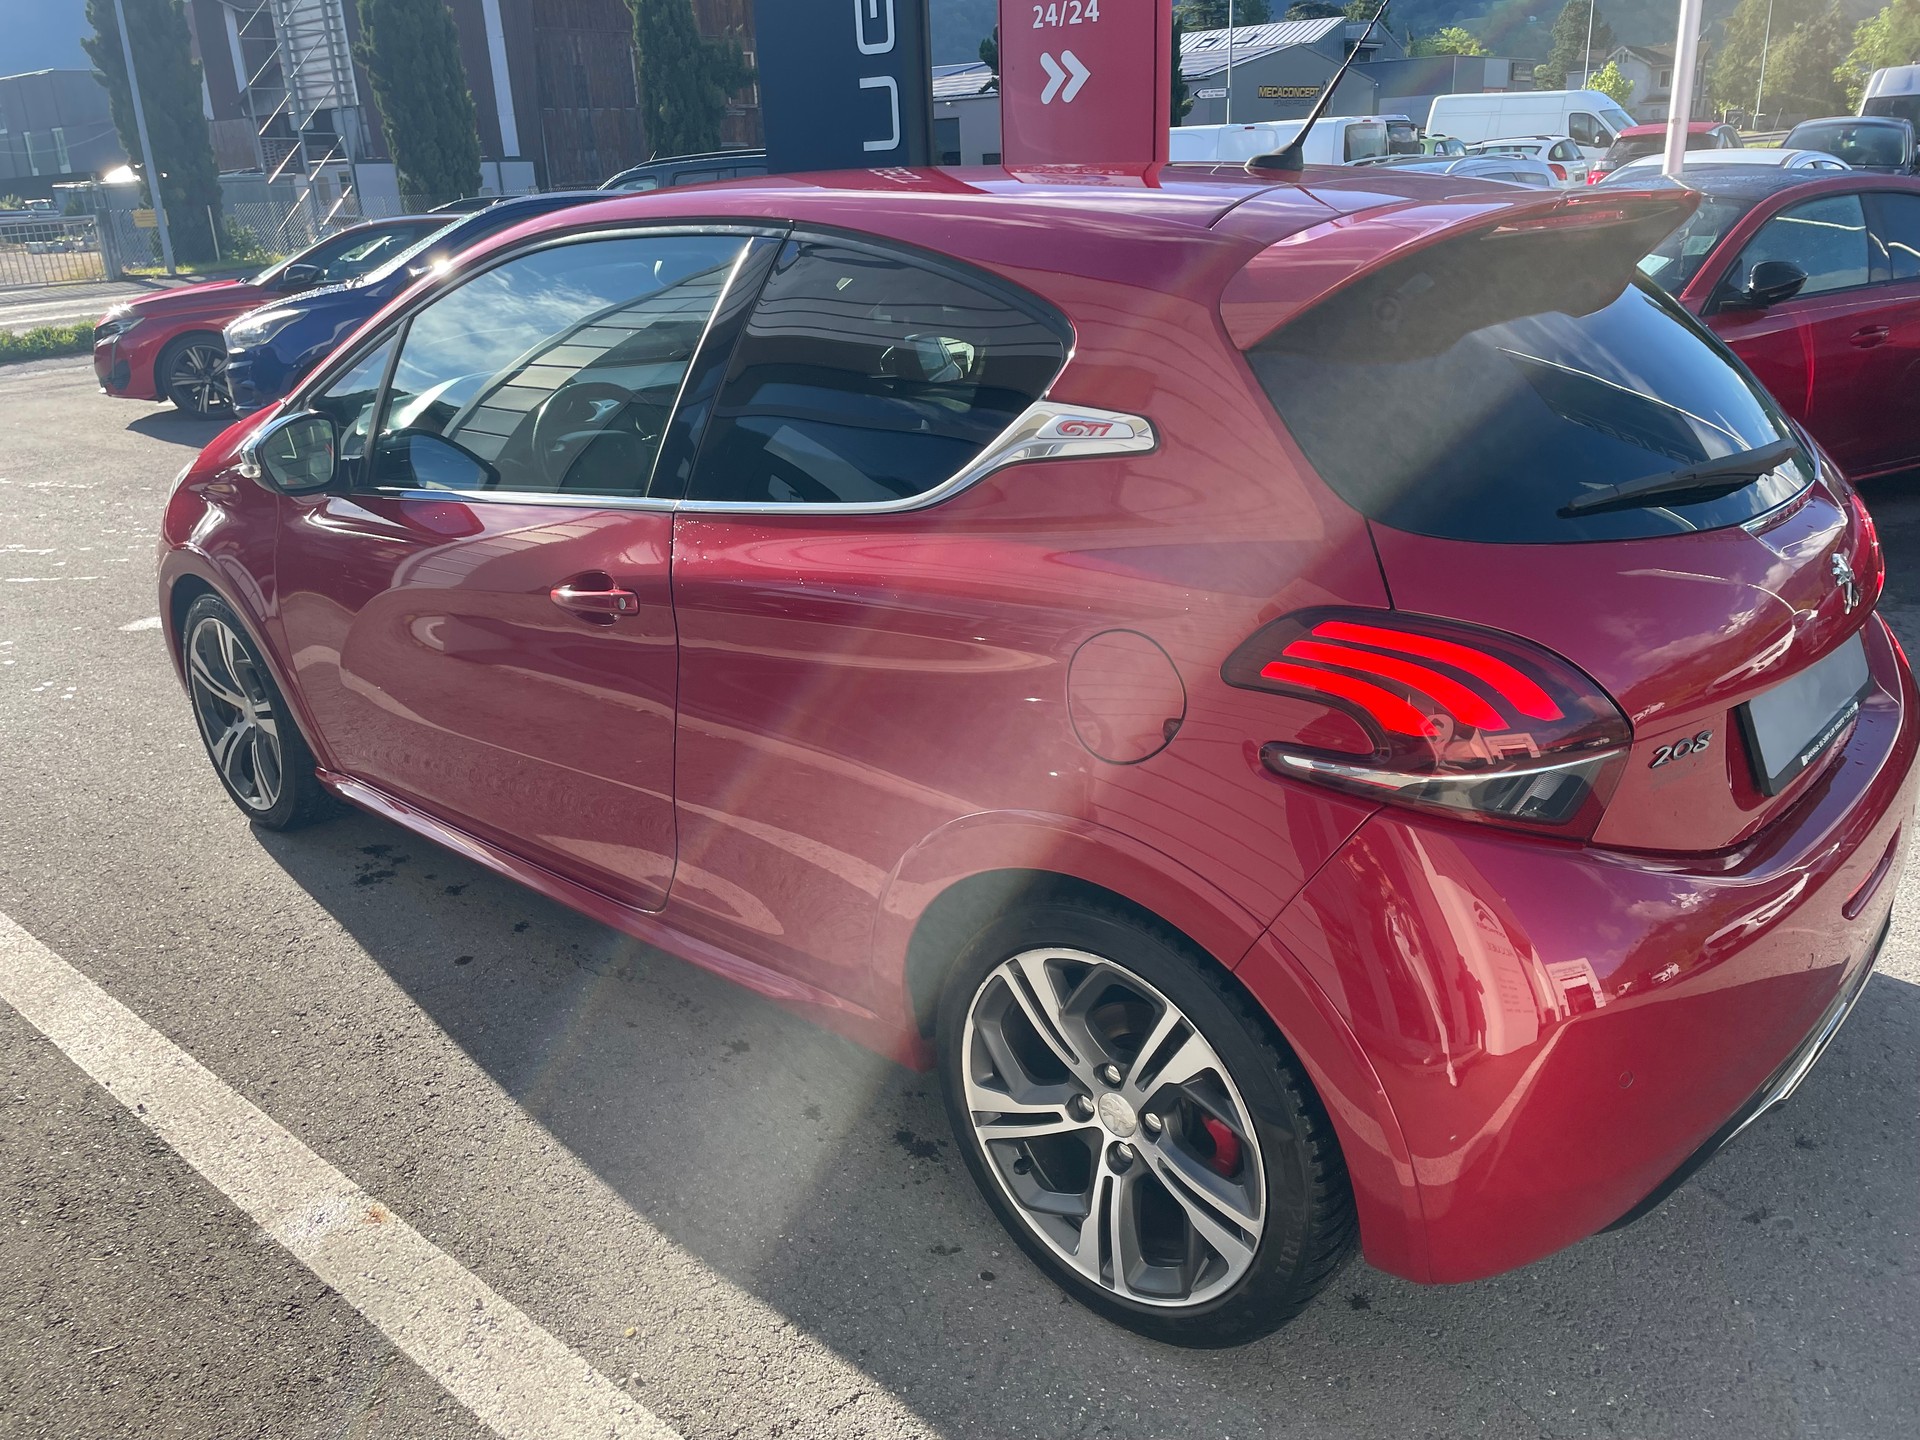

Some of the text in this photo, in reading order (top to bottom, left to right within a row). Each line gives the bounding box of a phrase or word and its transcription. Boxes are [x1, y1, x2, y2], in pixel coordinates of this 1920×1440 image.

[1032, 0, 1100, 29] 24/24
[1258, 86, 1320, 98] MECACONCEPT
[1648, 730, 1714, 769] 208
